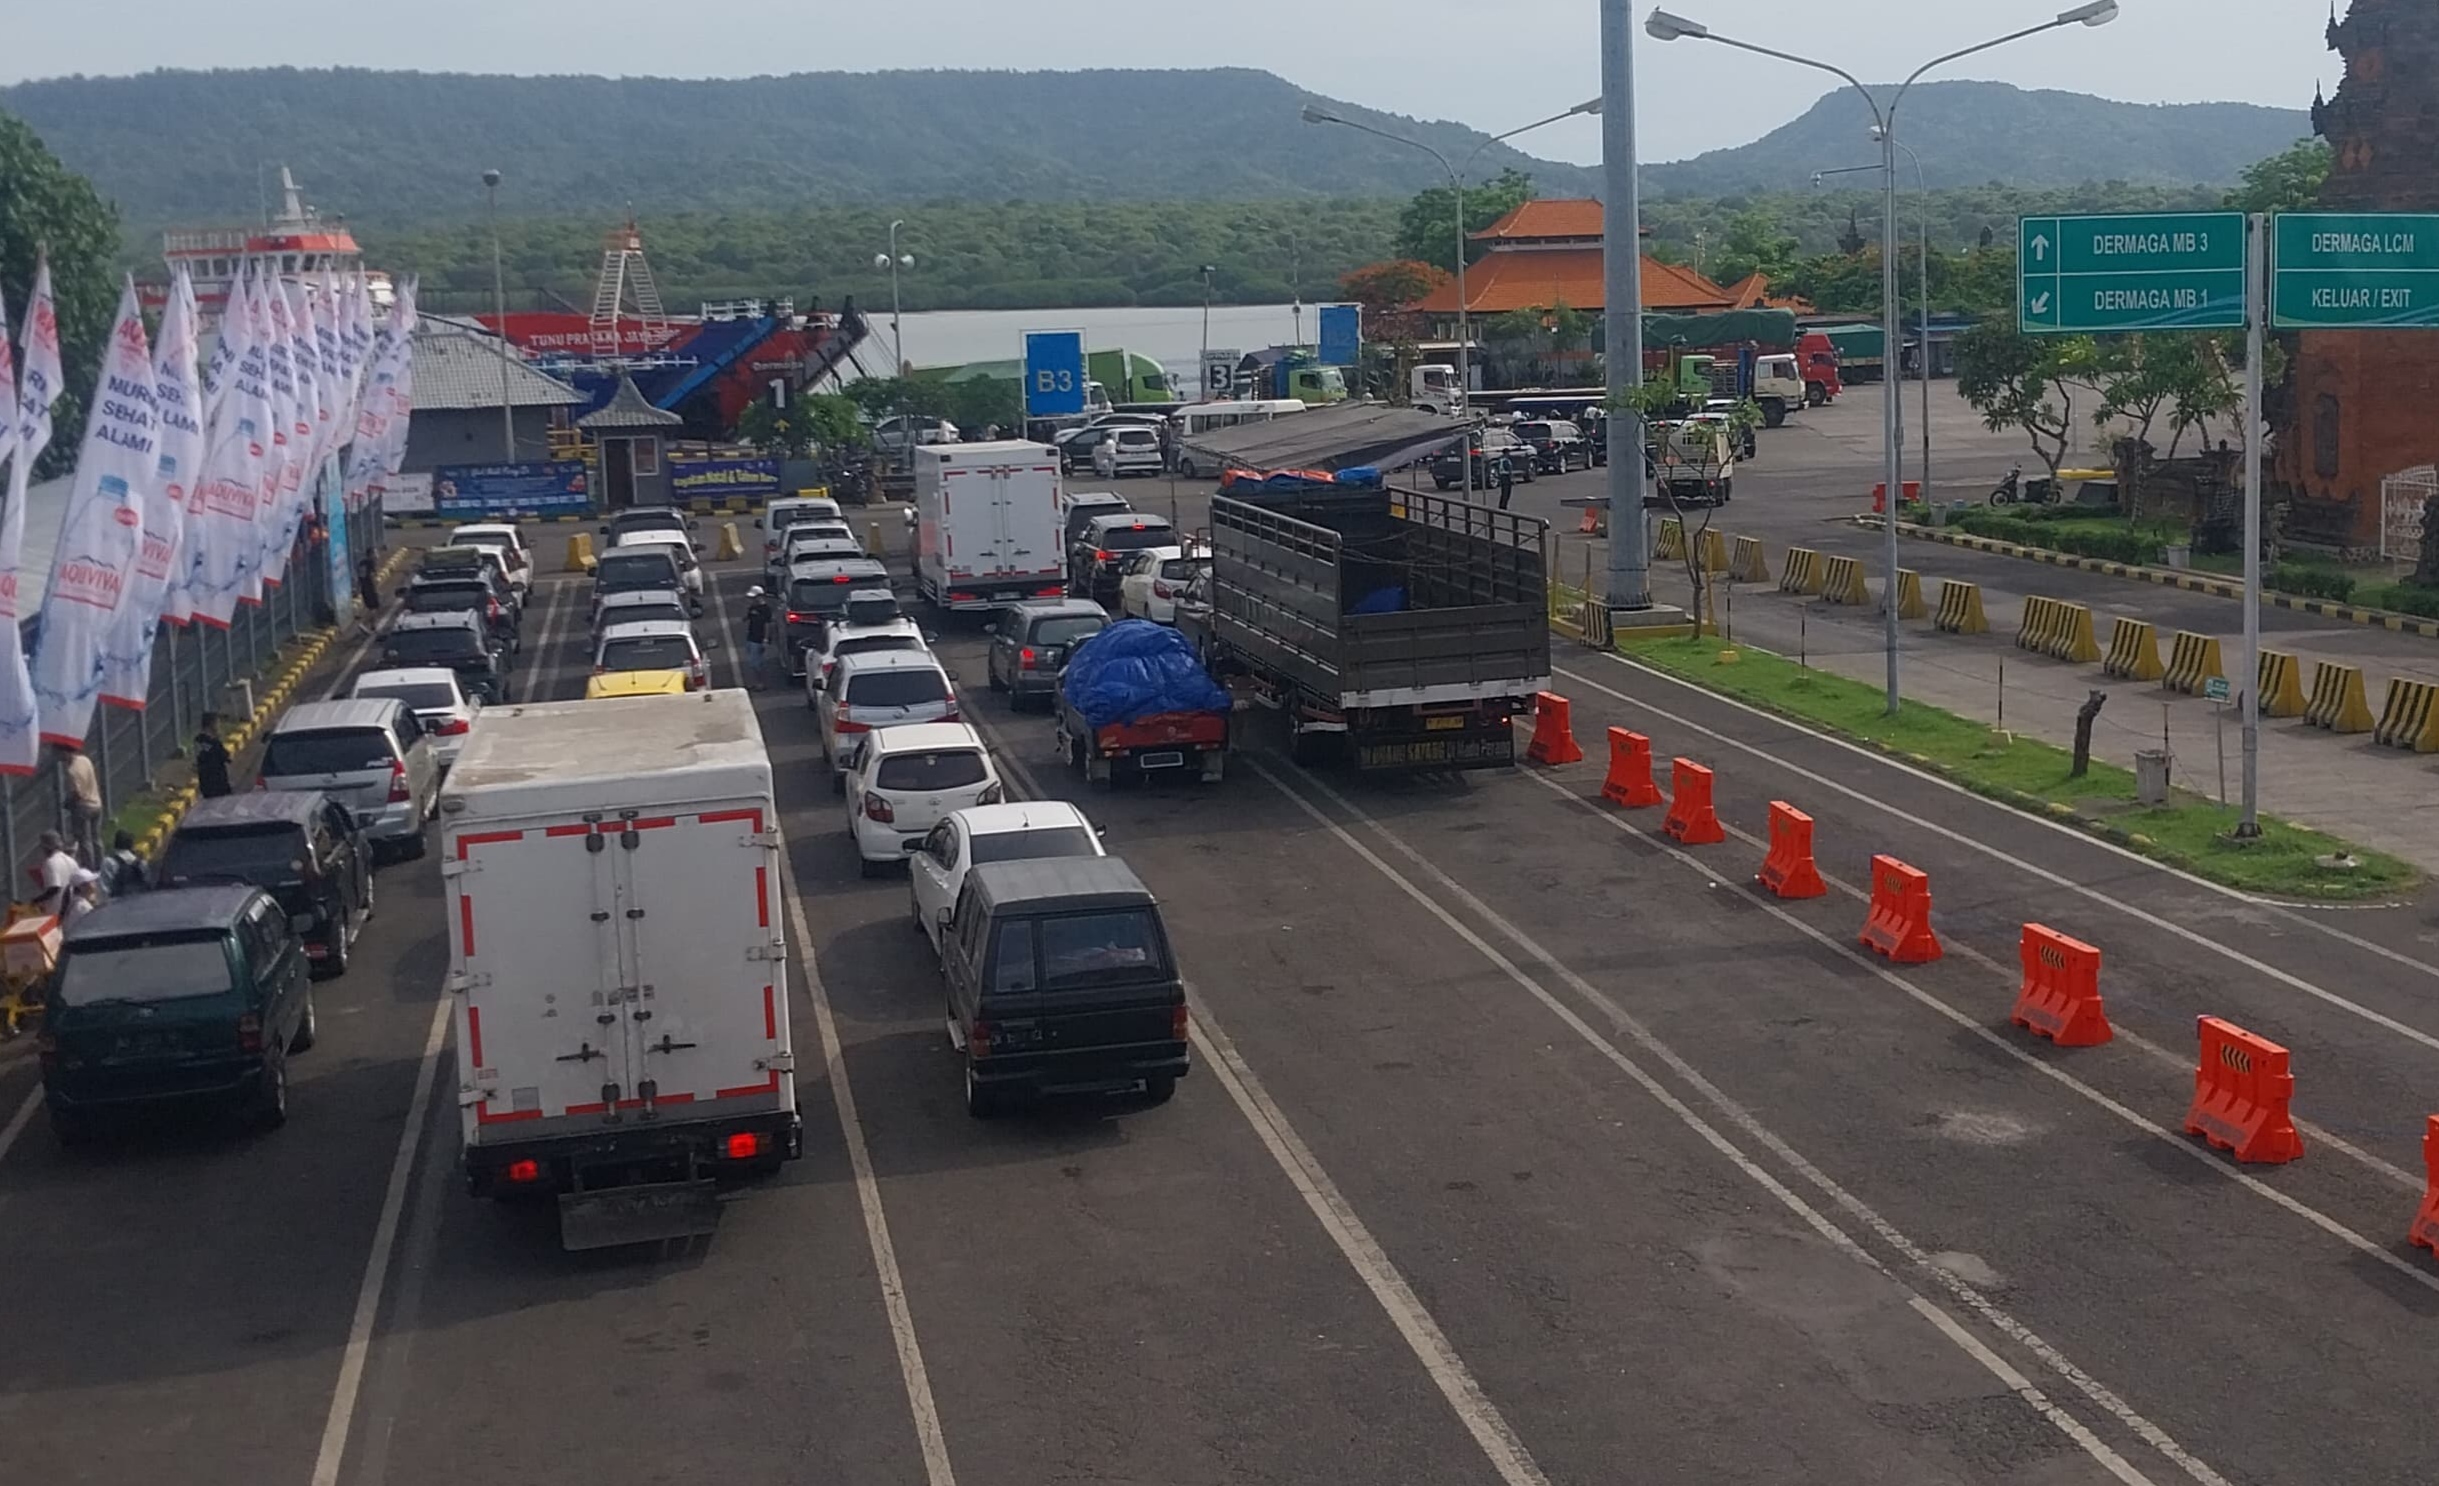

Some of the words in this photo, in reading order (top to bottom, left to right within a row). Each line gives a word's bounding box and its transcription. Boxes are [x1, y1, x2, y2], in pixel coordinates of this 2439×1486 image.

[2093, 233, 2169, 254] DERMAGA
[2173, 233, 2195, 252] MB
[2200, 233, 2208, 251] 3
[2312, 233, 2381, 253] DERMAGA
[2385, 234, 2414, 252] LCM
[2094, 290, 2170, 310] DERMAGA
[2174, 289, 2196, 308] MB
[2201, 289, 2208, 308] 1
[2312, 289, 2370, 308] KELUAR
[2373, 289, 2378, 307] /
[2381, 289, 2412, 307] EXIT
[530, 334, 565, 346] TUNU
[1037, 369, 1073, 393] B3
[1212, 365, 1228, 389] 3
[768, 378, 786, 408] 1
[95, 424, 154, 454] ALAMI
